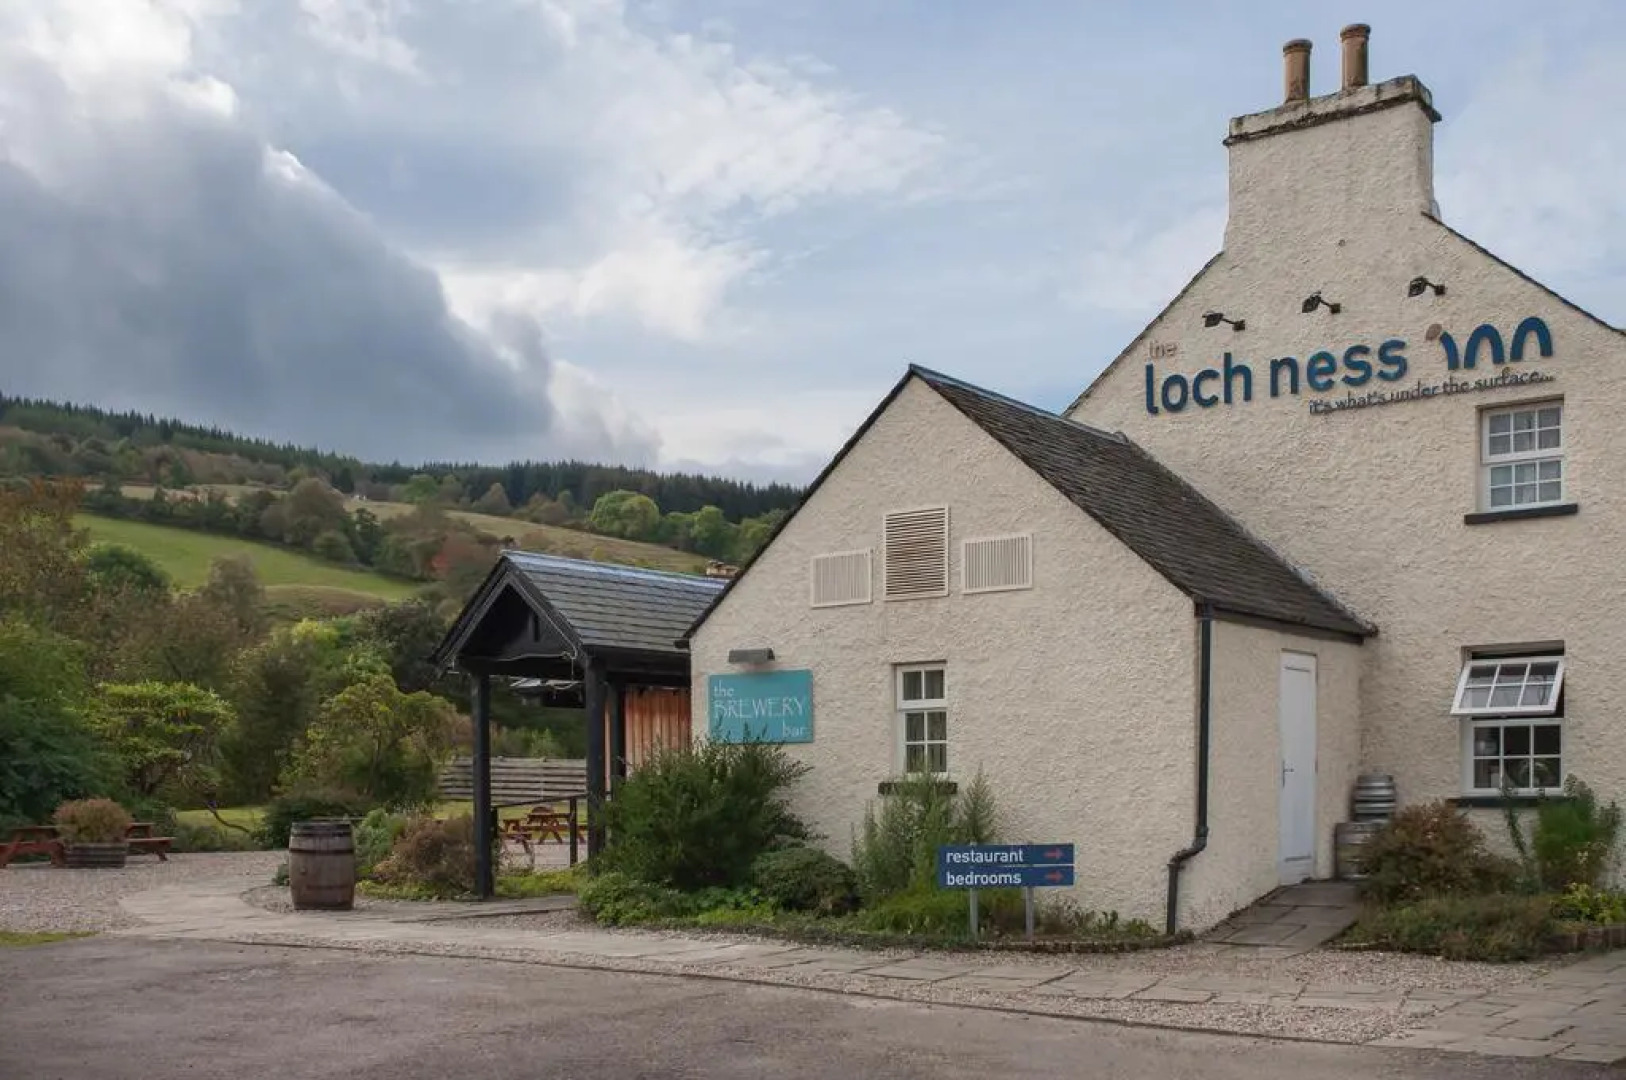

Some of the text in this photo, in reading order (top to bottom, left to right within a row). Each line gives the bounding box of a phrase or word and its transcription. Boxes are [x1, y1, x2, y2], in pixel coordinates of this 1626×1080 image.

[1149, 339, 1177, 357] the
[1145, 316, 1554, 415] loch ness inn
[1309, 399, 1332, 414] it's
[1334, 390, 1386, 409] what's
[1390, 379, 1439, 402] under
[1442, 373, 1469, 393] the
[713, 679, 735, 697] the
[713, 696, 806, 719] BREWERY
[782, 719, 808, 738] bar
[946, 849, 1024, 863] restaurant
[946, 872, 1022, 886] bedrooms
